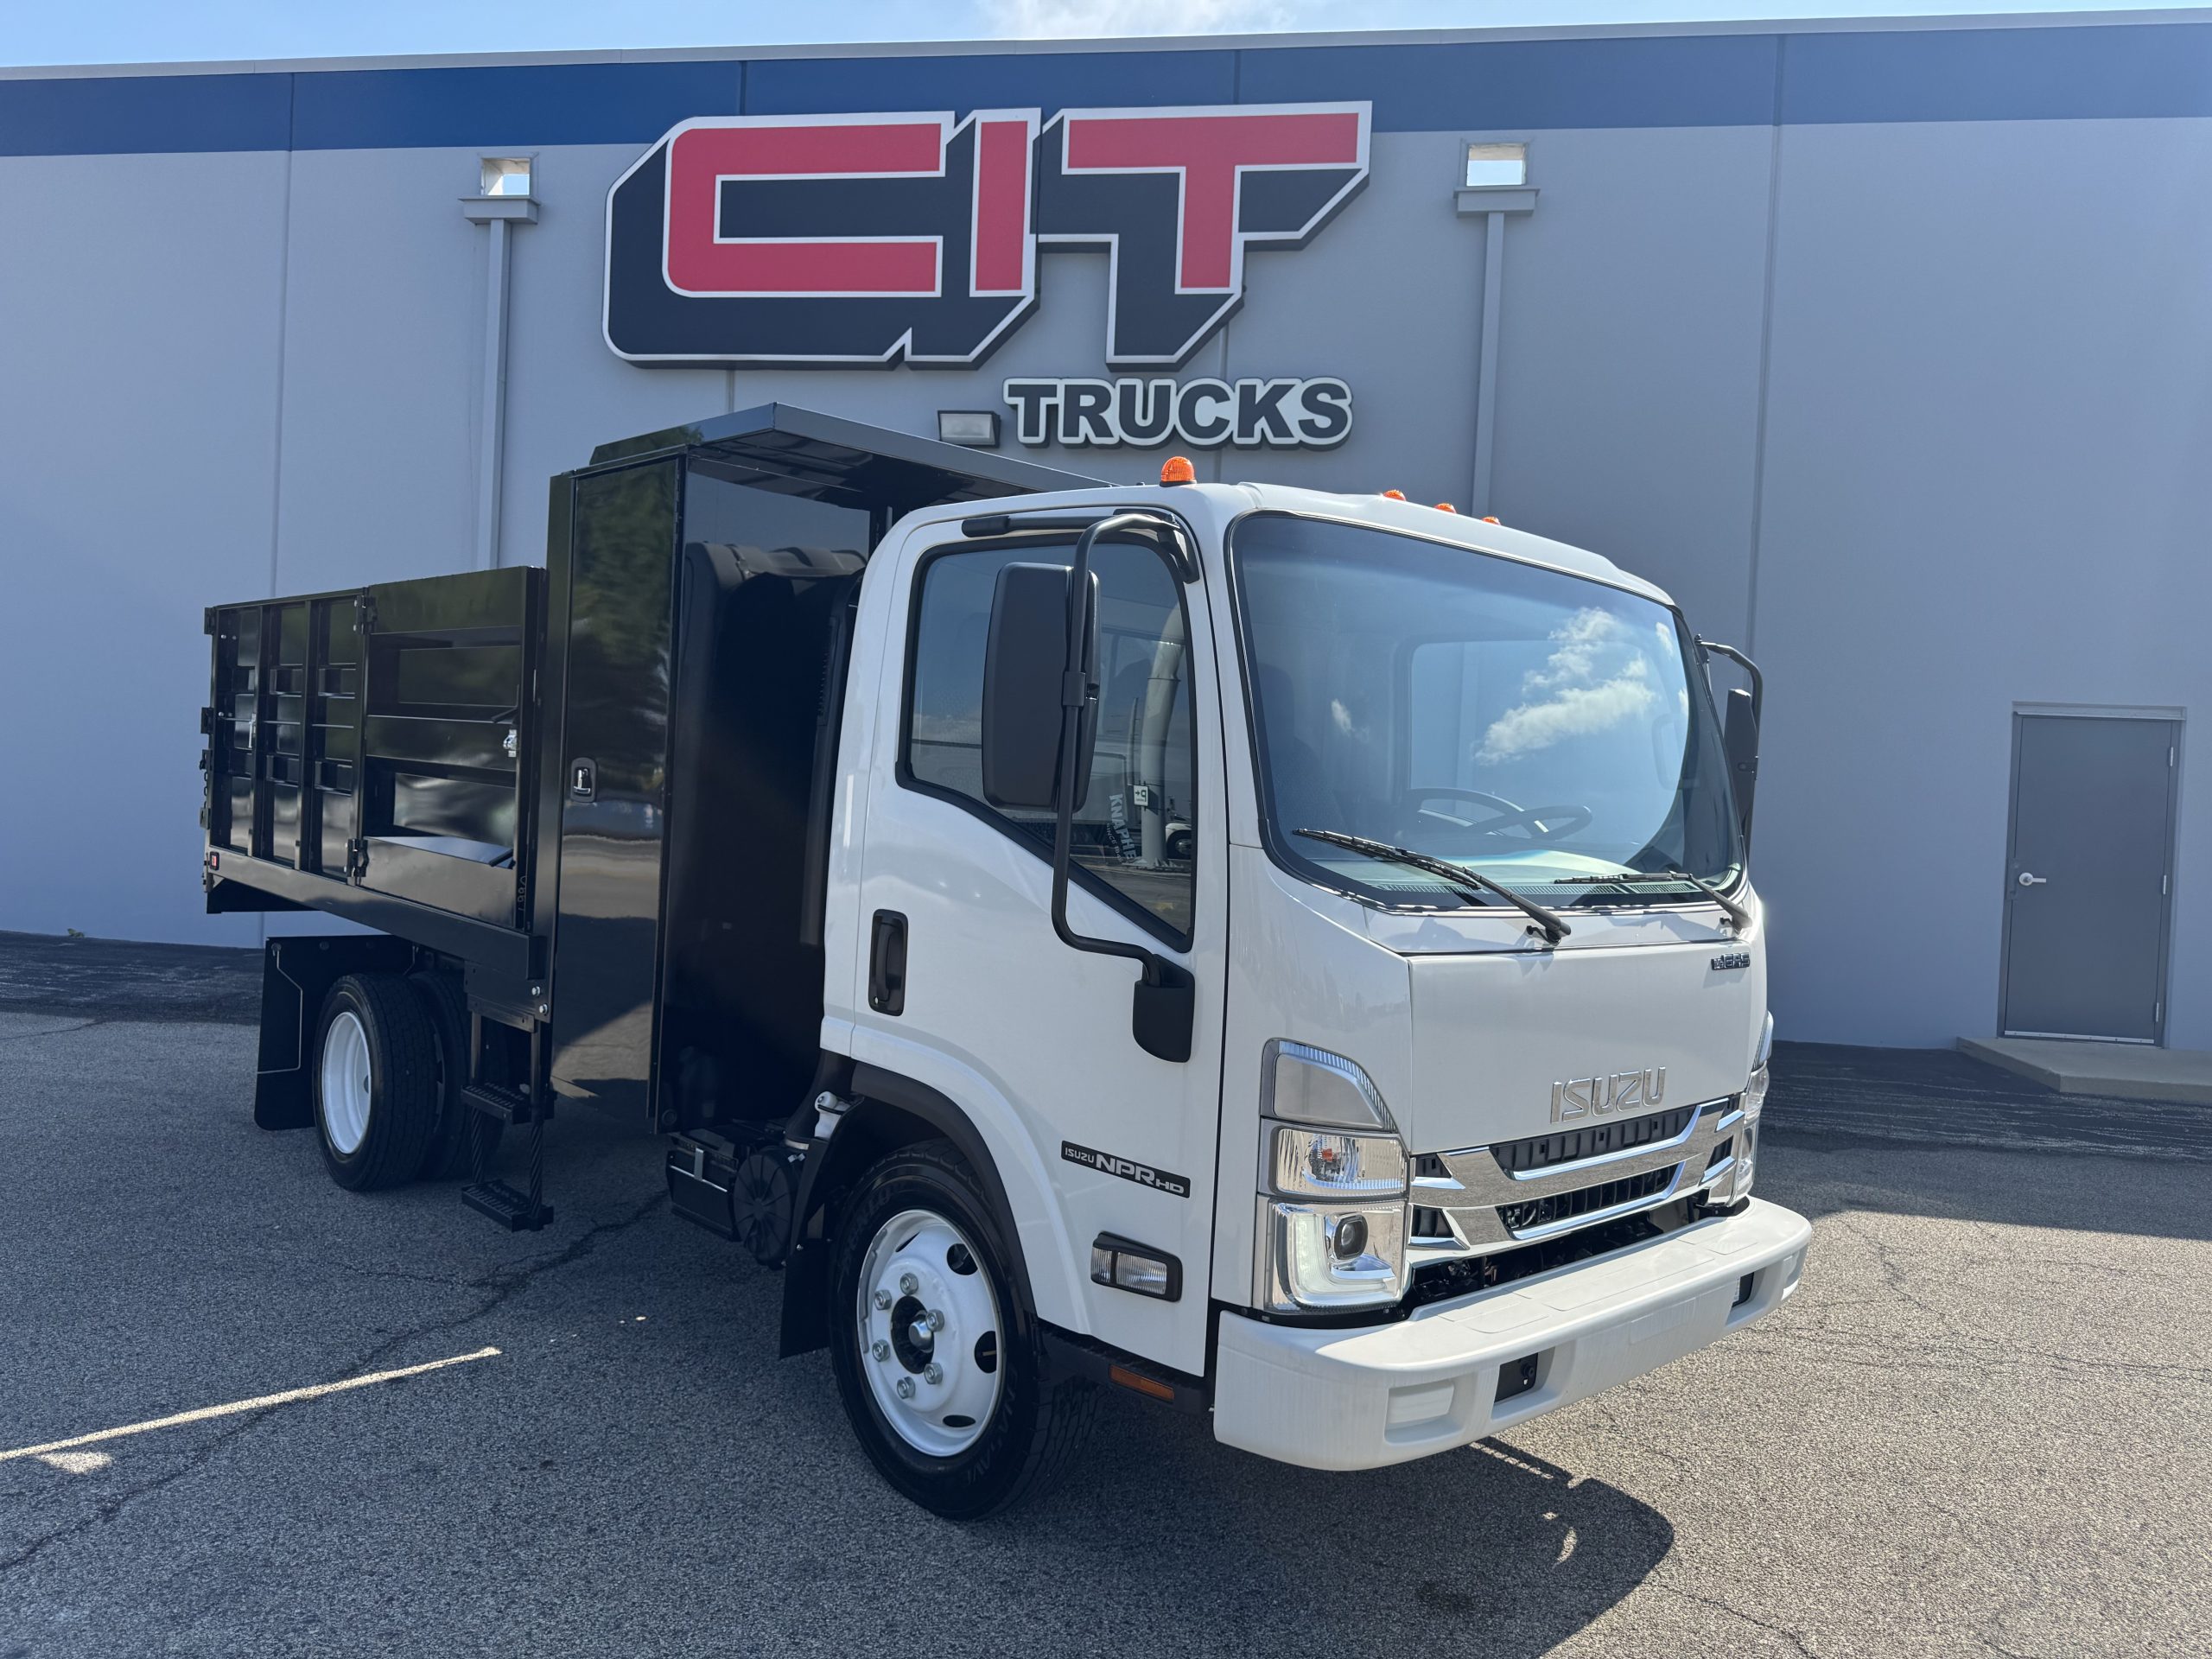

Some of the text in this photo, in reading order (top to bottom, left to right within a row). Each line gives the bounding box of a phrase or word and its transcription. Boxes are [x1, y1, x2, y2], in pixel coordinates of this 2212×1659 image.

[660, 101, 1372, 301] CIT
[1005, 379, 1351, 442] TRUCKS
[1550, 1066, 1666, 1123] ISUZU
[1065, 1147, 1185, 1194] ISUZU NPR HD
